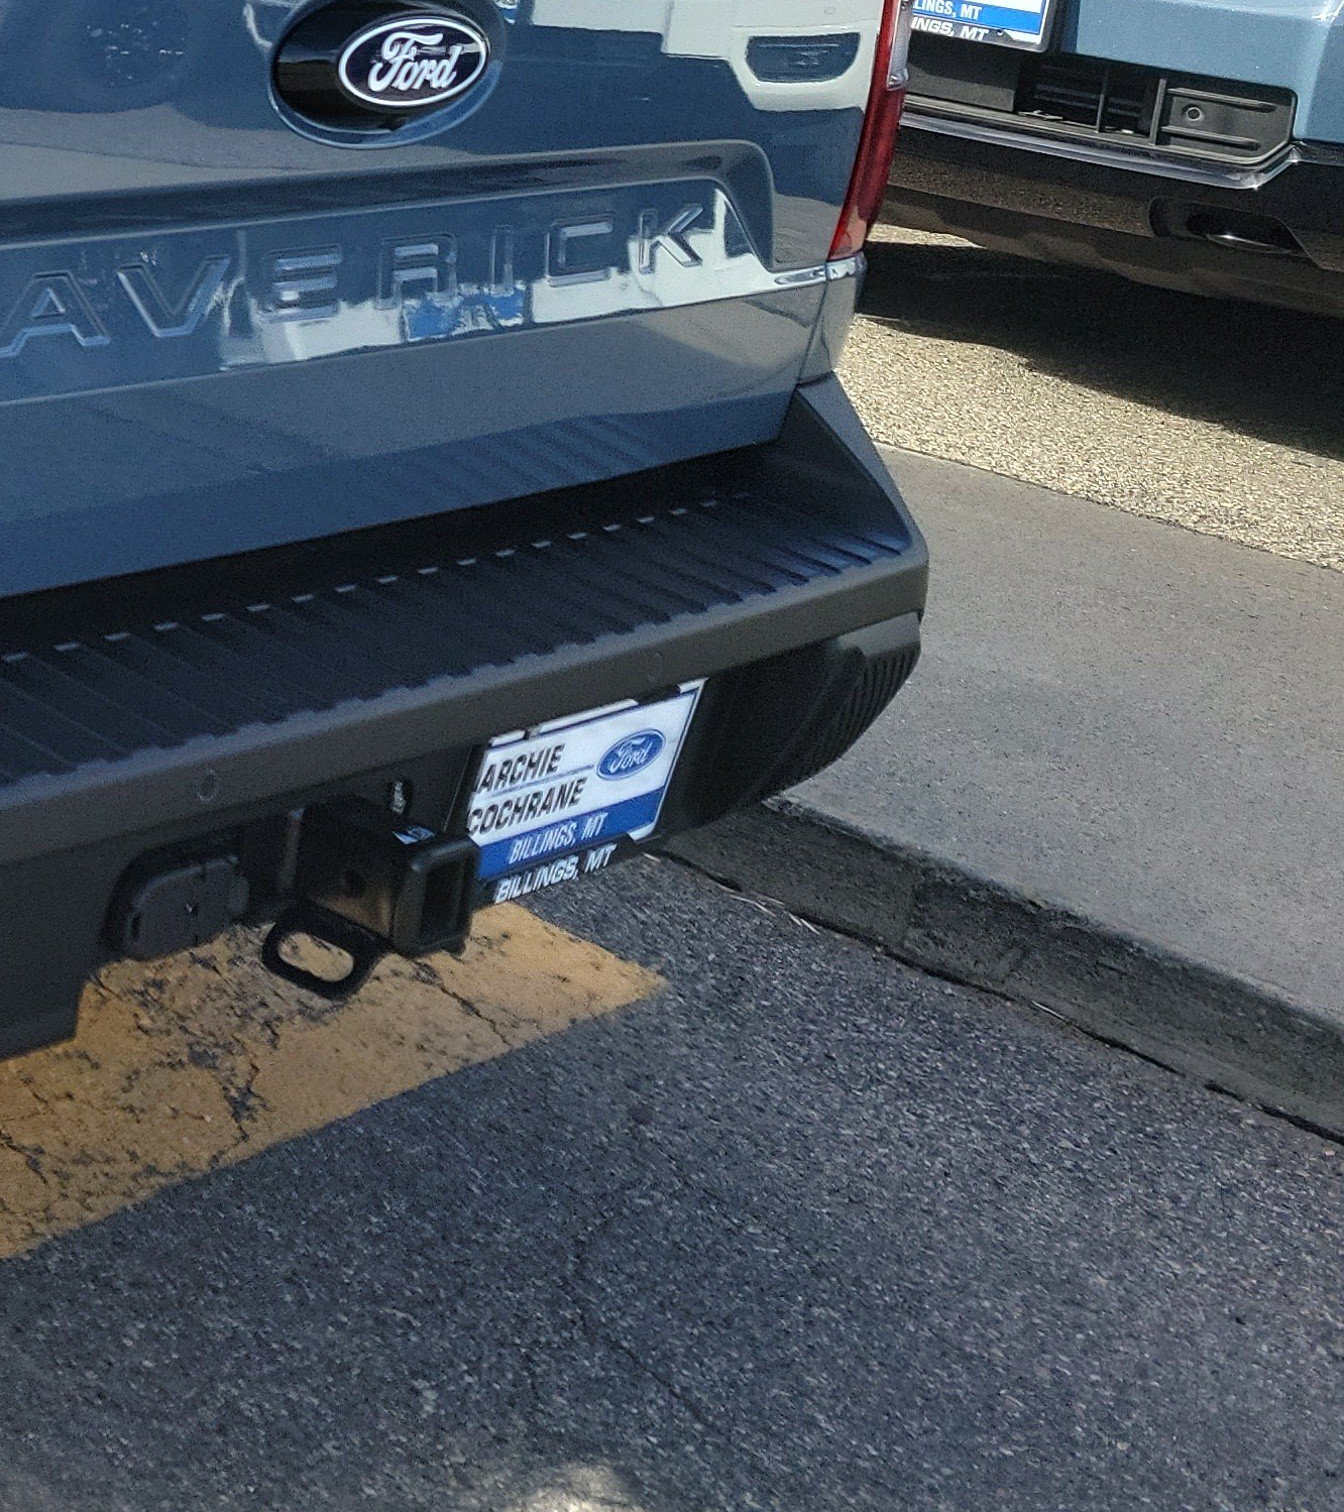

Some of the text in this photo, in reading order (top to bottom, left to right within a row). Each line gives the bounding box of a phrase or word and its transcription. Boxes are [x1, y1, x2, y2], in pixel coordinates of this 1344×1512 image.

[960, 3, 982, 20] MT
[961, 25, 989, 41] MT
[368, 32, 463, 93] Ford
[478, 744, 565, 794] ARCHIE
[609, 737, 654, 772] Ford
[467, 777, 588, 835] COCHRANE
[508, 813, 609, 865] BILLINGS, MT
[494, 845, 617, 903] BILLINGS, MT
